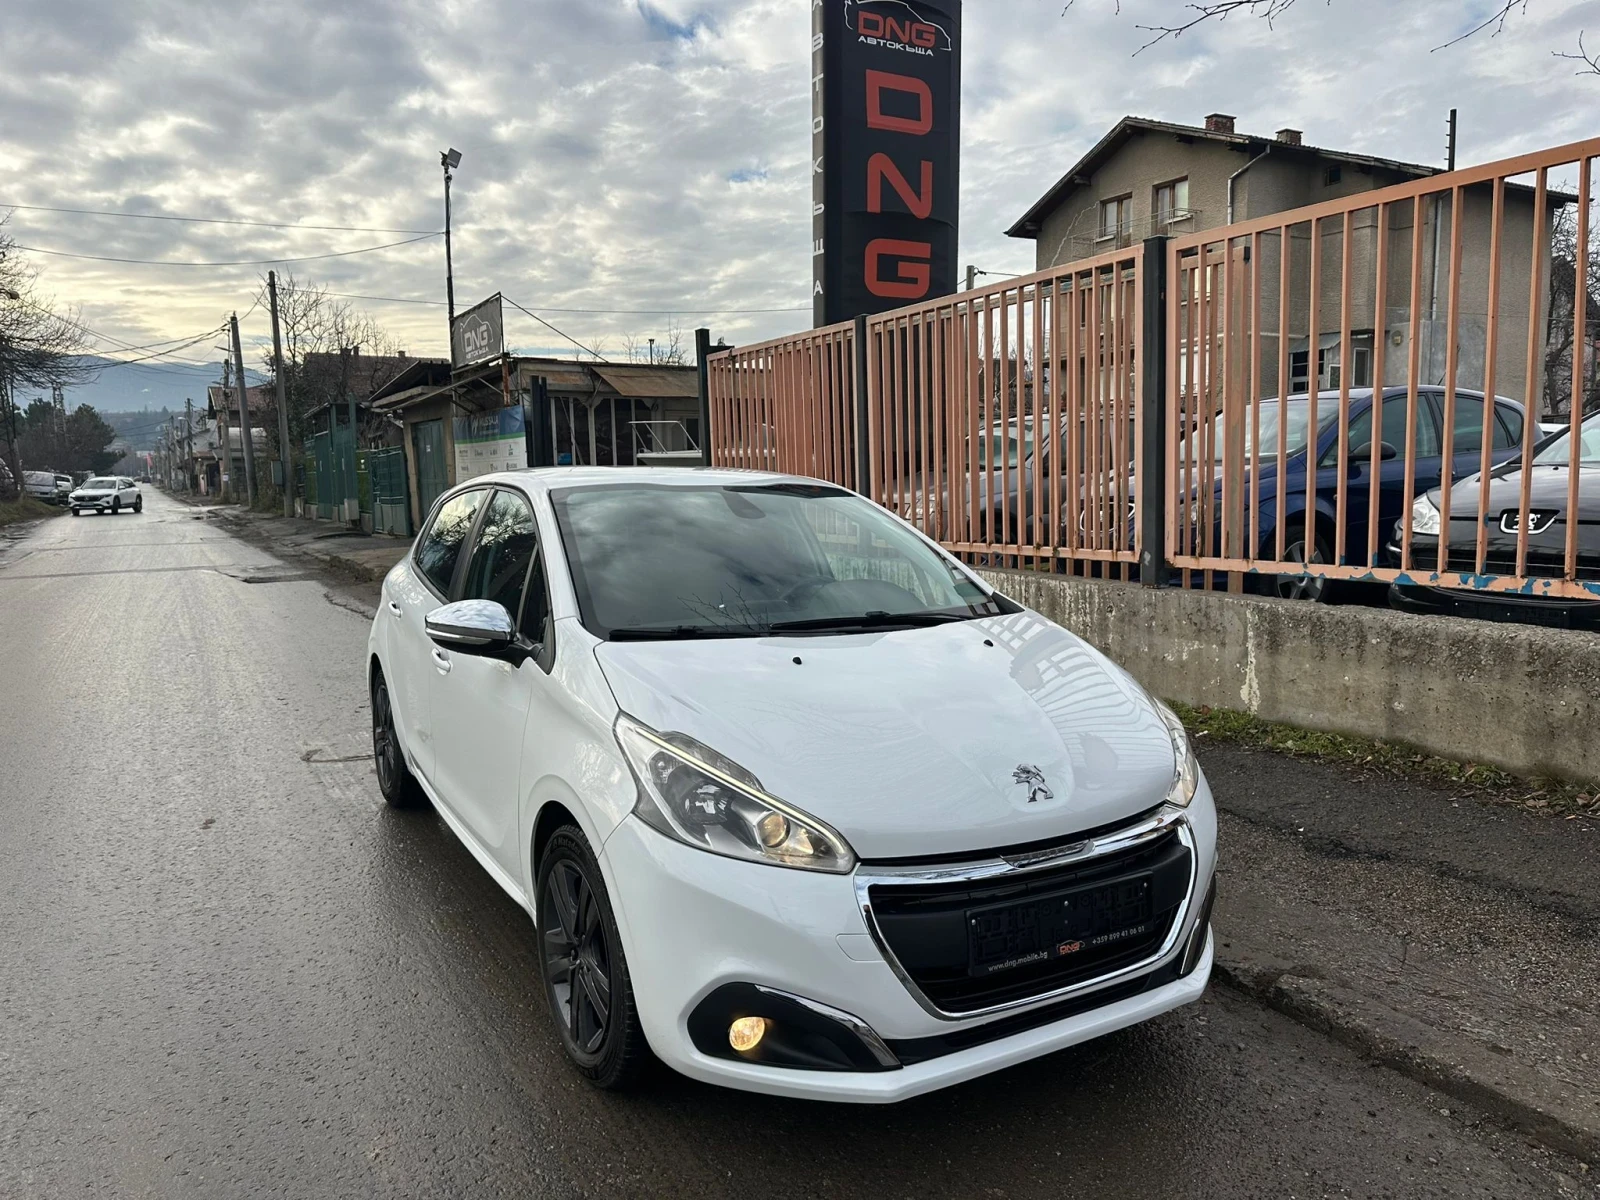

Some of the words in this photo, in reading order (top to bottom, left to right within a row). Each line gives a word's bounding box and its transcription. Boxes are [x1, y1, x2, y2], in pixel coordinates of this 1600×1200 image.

[858, 11, 936, 48] DNG
[858, 35, 934, 56] АВТОКЪЩА
[864, 69, 933, 299] DNG
[464, 324, 488, 352] DNG
[988, 951, 1048, 971] www.dng.mobile.bg
[1092, 935, 1108, 945] +359
